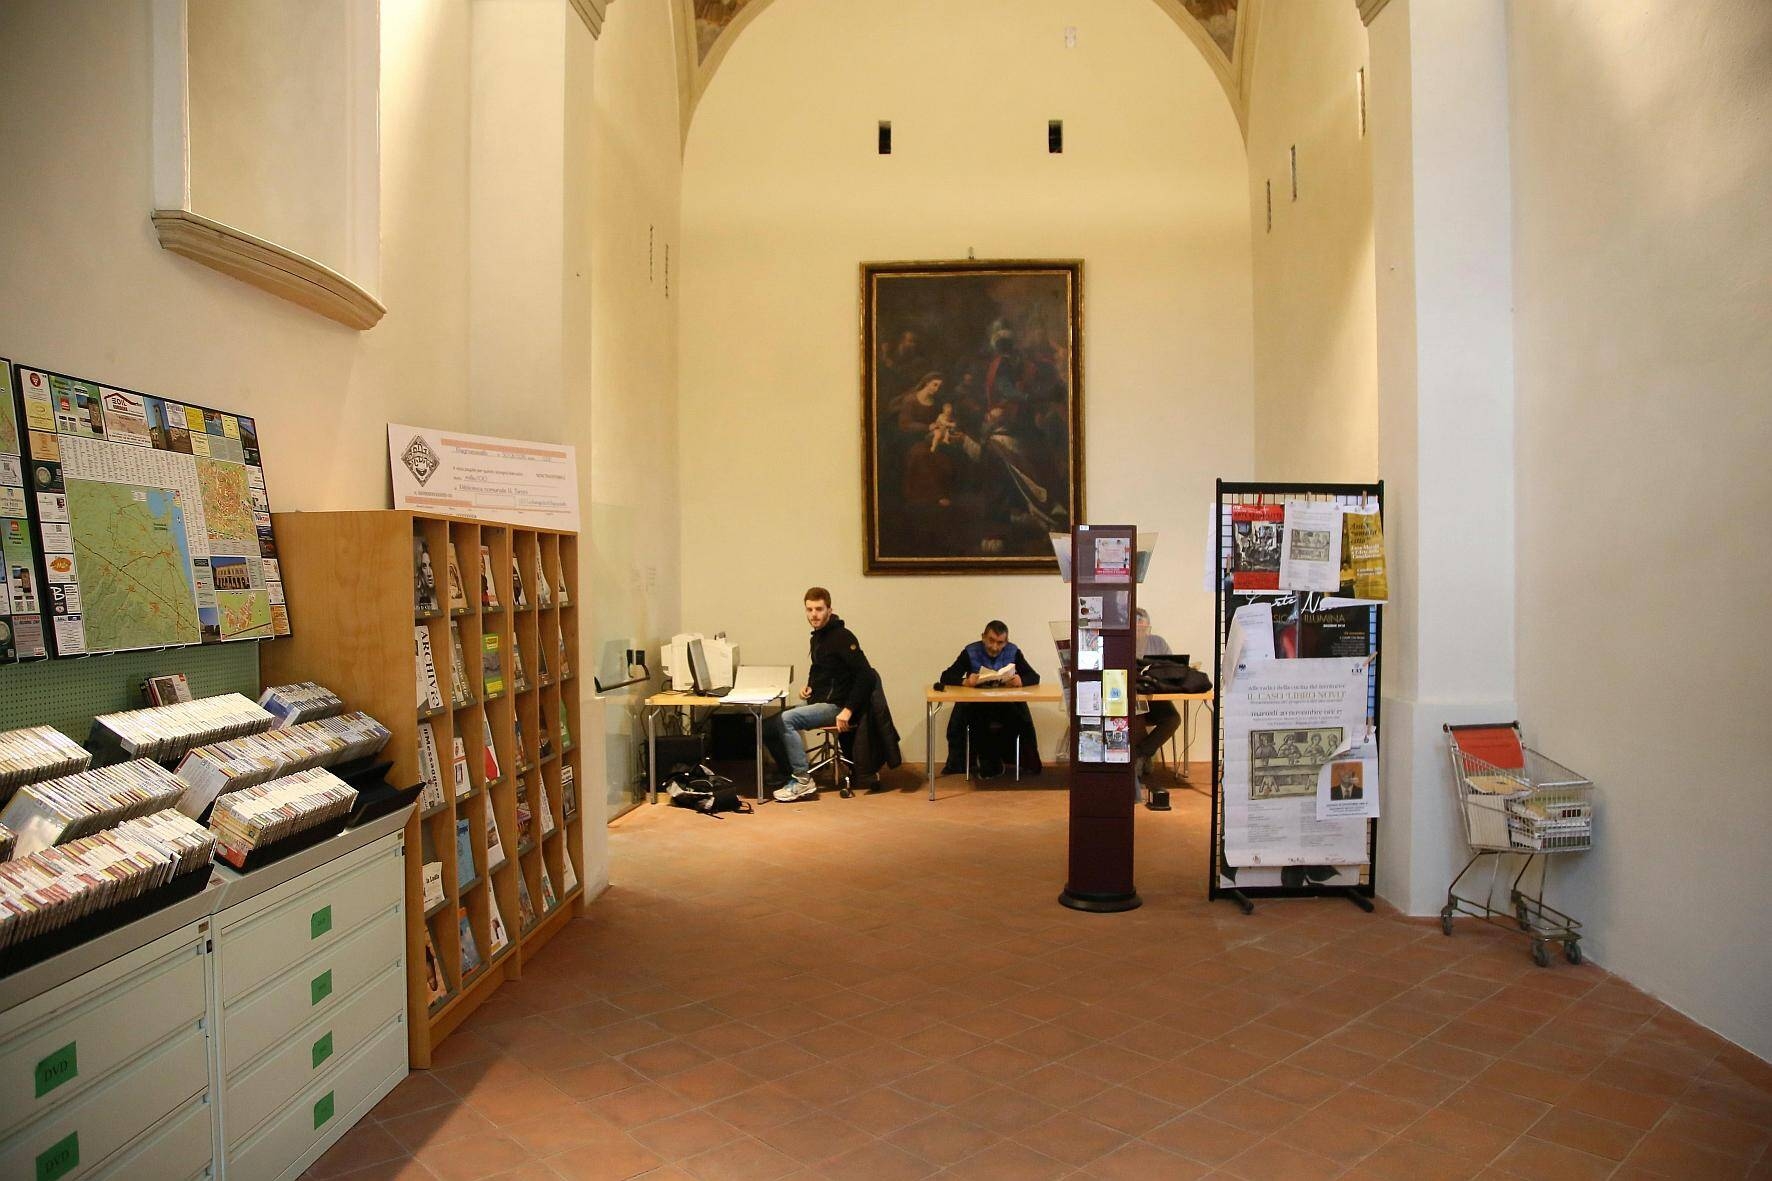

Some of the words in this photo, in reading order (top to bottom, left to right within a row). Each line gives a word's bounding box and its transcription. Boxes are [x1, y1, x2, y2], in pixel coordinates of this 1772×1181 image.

[1304, 614, 1346, 623] ILLUMINA
[43, 1059, 68, 1081] DVD
[45, 1149, 70, 1173] DVD
